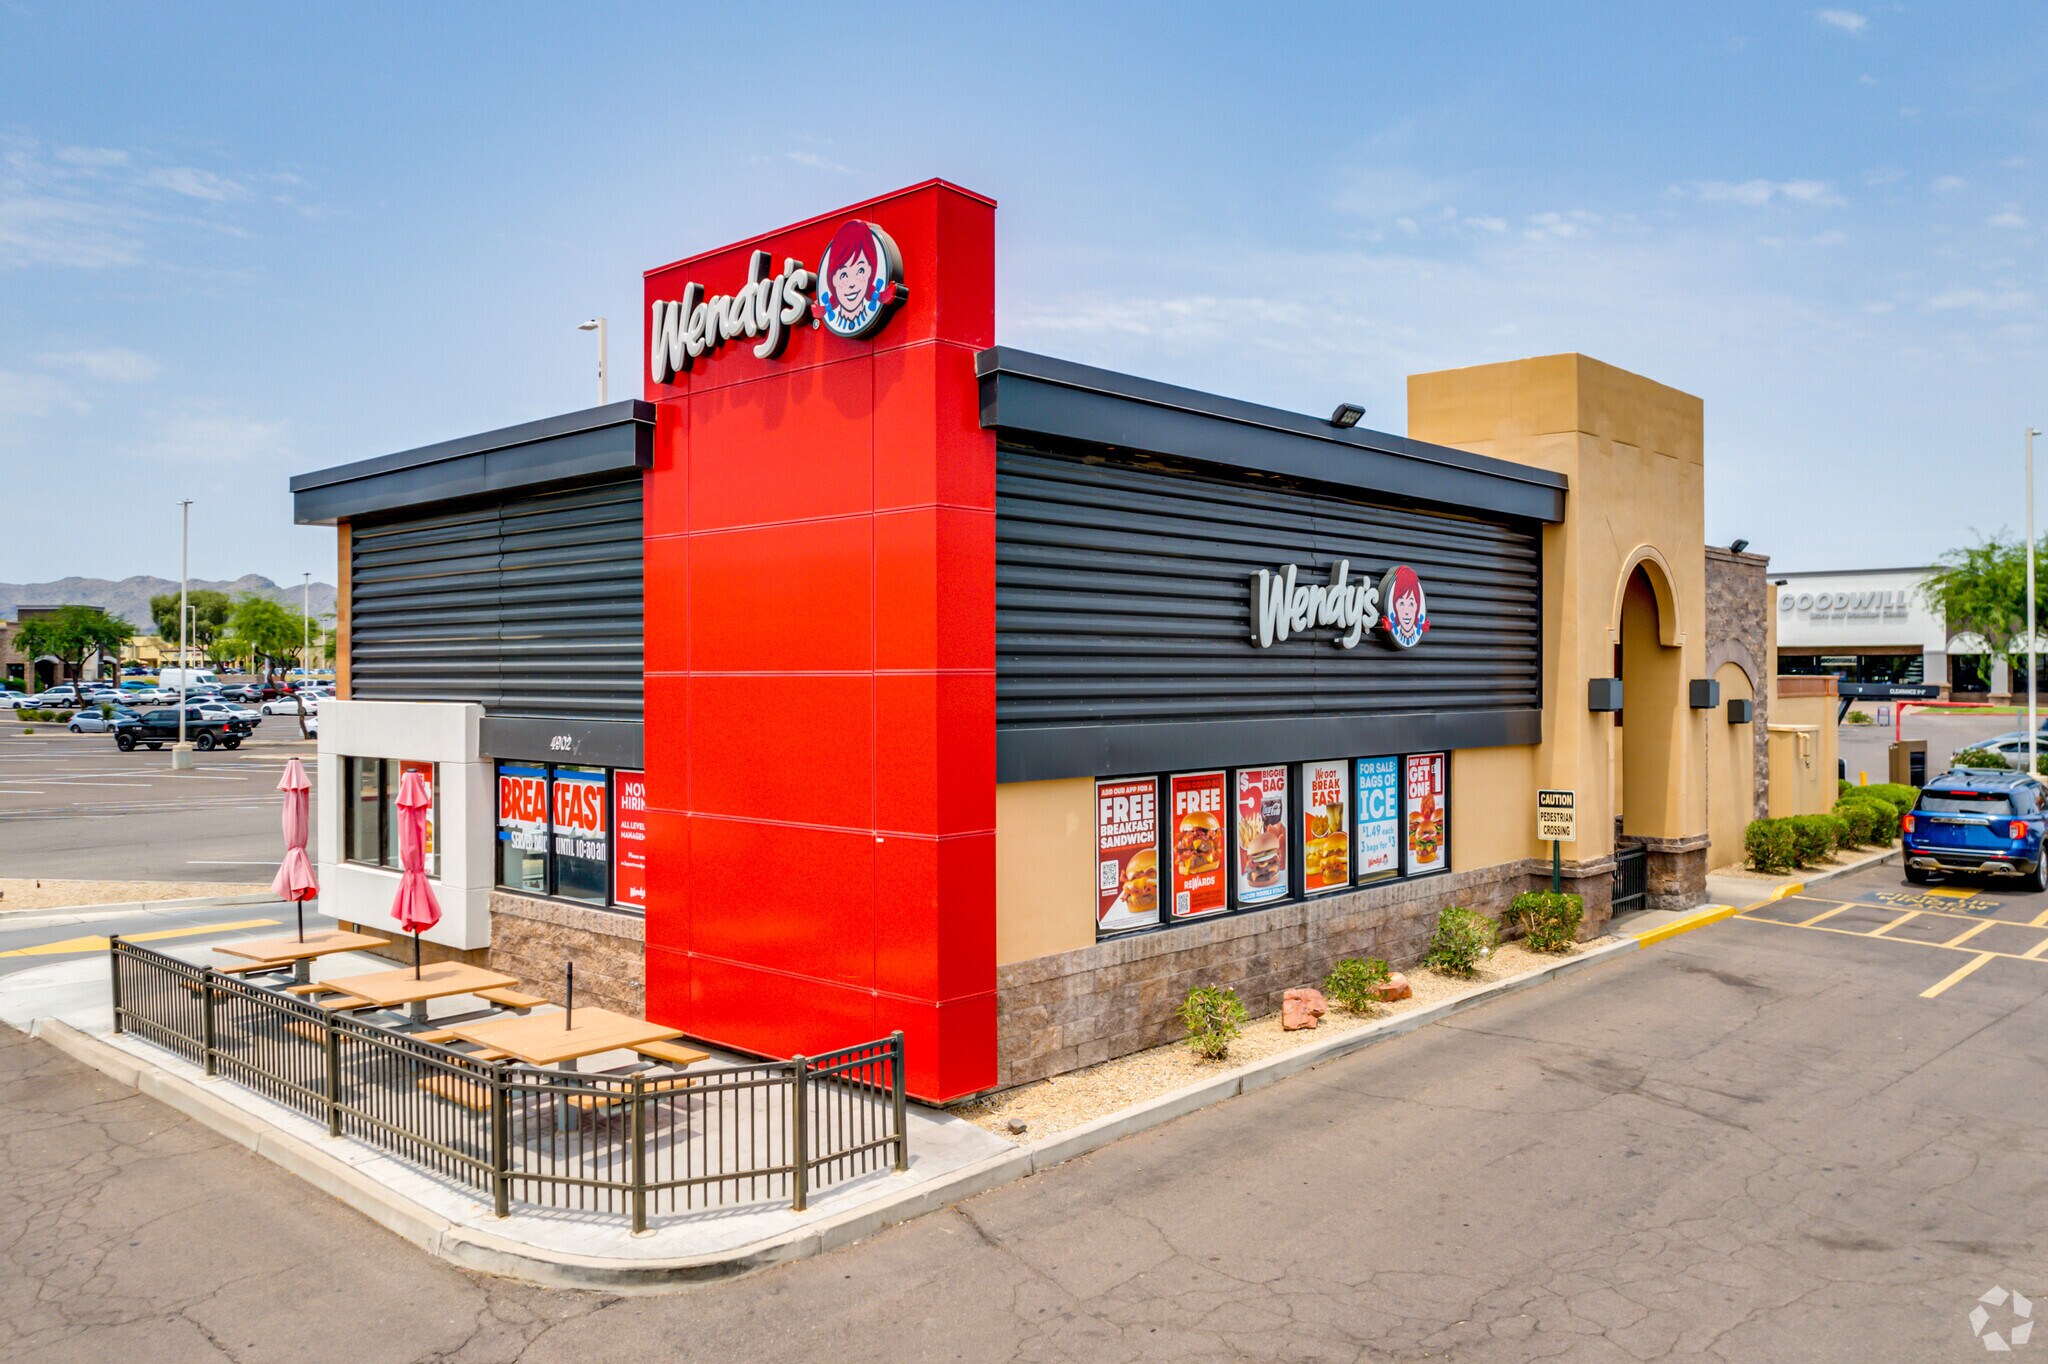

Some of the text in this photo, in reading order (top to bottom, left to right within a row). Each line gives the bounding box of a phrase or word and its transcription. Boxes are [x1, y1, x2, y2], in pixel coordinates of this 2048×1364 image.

[652, 249, 813, 384] Wendy's
[1252, 559, 1380, 649] Wendy's
[1779, 590, 1907, 612] GOODWILL
[1262, 769, 1284, 779] BIGGIE
[1324, 770, 1337, 779] GOT
[1360, 761, 1396, 774] FOR SALE:
[1410, 765, 1430, 783] GET
[1262, 777, 1285, 792] BAG
[1312, 779, 1340, 791] BREAK
[1360, 773, 1395, 789] BAGS OF
[1410, 781, 1430, 798] ONE
[1176, 788, 1220, 815] FREE
[1312, 789, 1341, 807] FAST
[1360, 787, 1396, 820] ICE
[1540, 793, 1573, 806] CAUTION
[1101, 793, 1154, 825] FREE
[1540, 811, 1573, 822] PEDESTRIAN
[1100, 819, 1154, 837] BREAKFAST
[1543, 825, 1571, 836] CROSSING
[1100, 831, 1154, 849] SANDWICH
[1184, 876, 1216, 891] REWARDS
